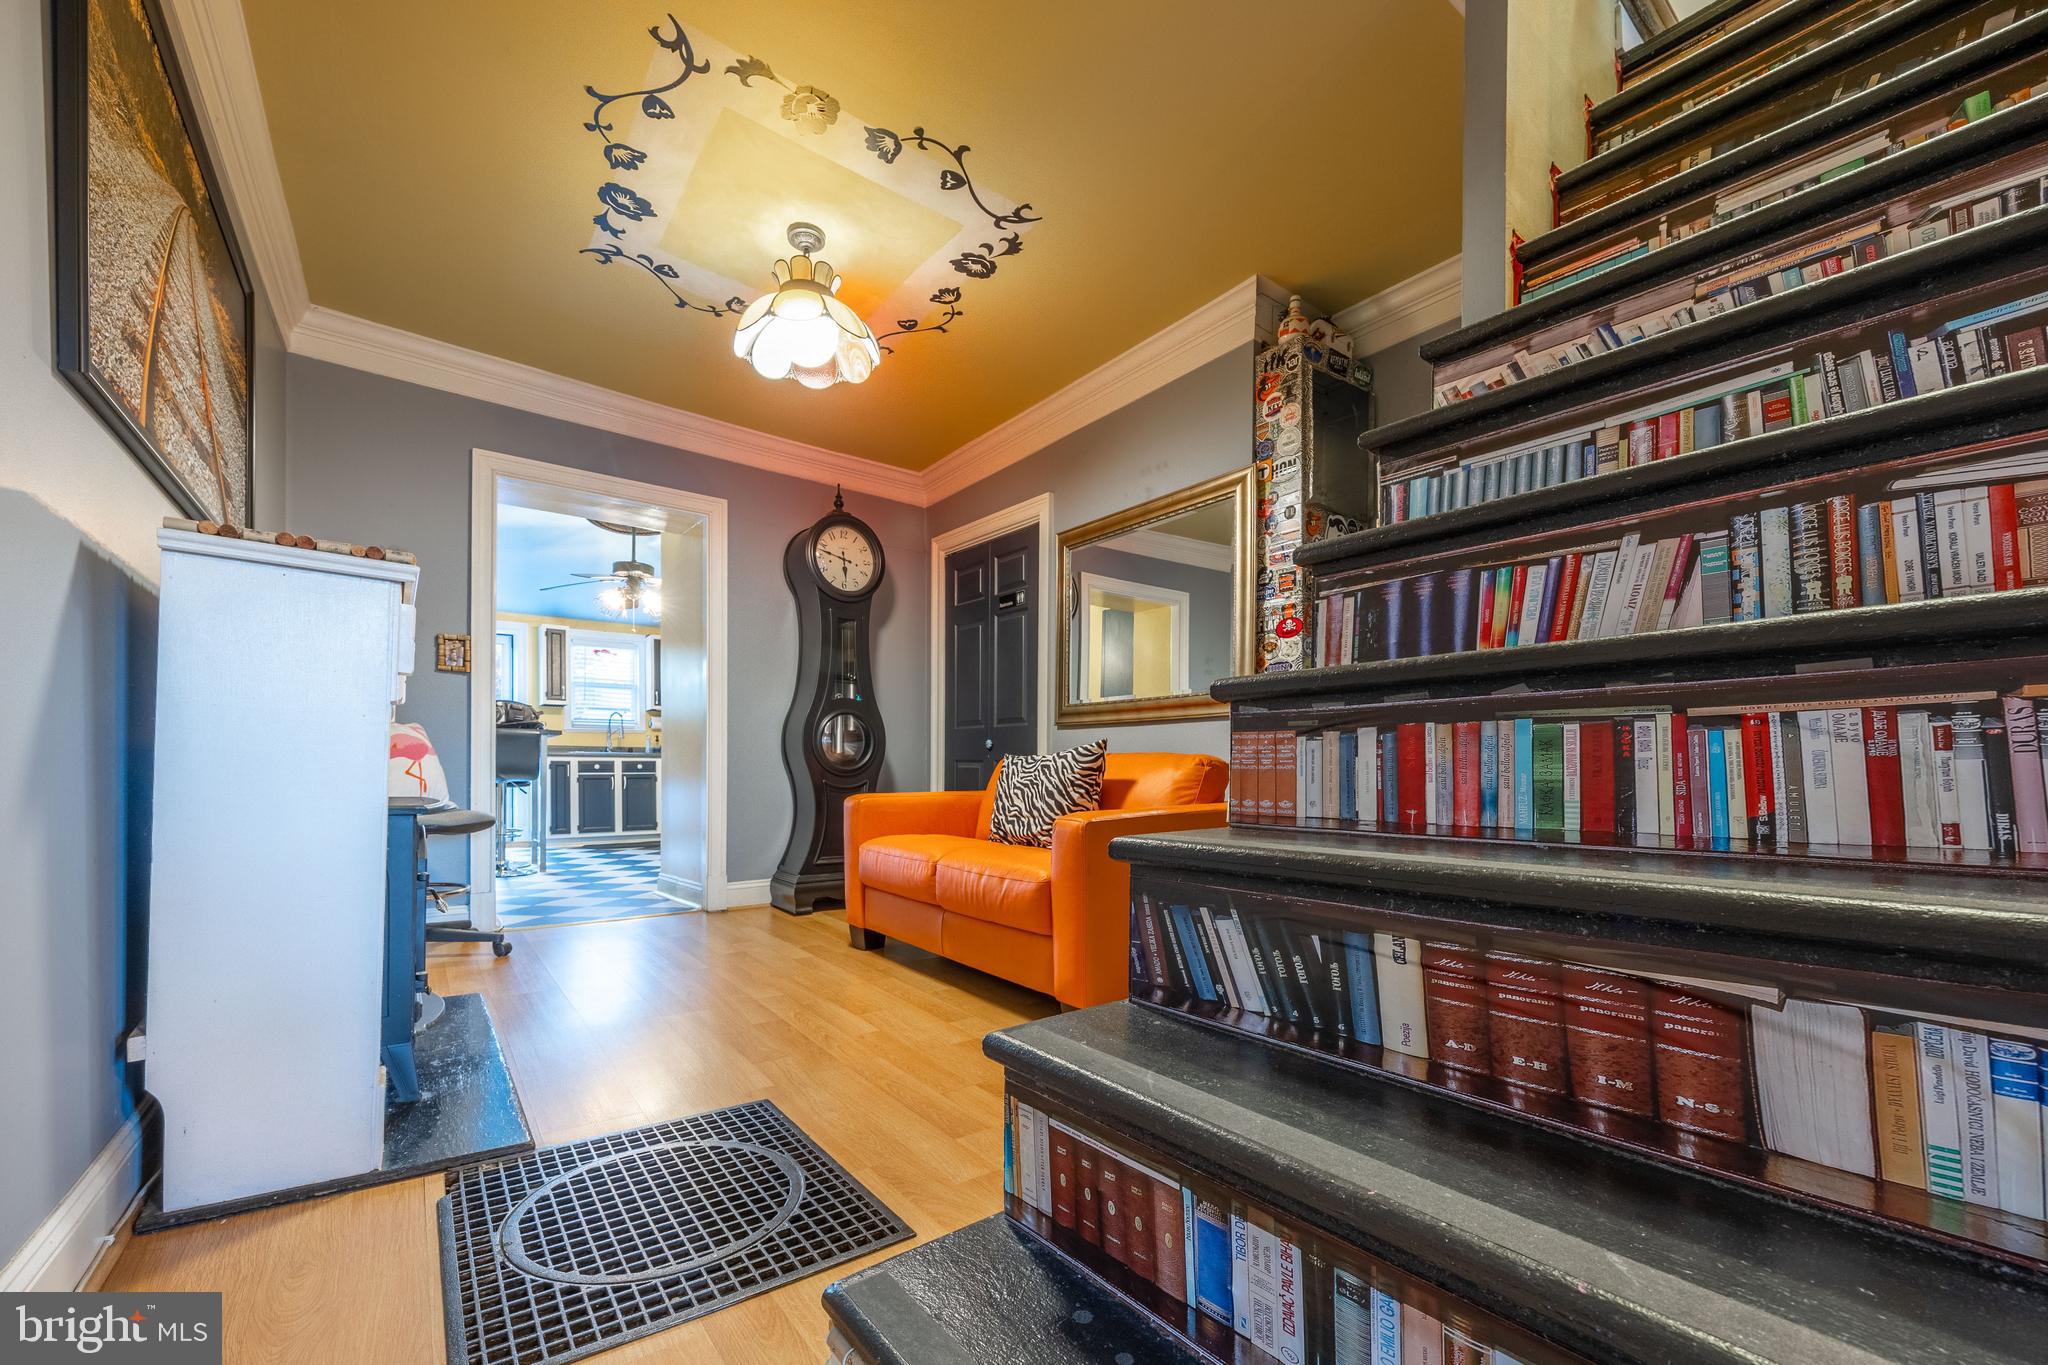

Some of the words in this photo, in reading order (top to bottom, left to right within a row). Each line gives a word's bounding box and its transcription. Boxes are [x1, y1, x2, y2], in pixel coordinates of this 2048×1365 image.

[1822, 352, 1835, 371] svega
[1826, 371, 1837, 386] srce
[1880, 370, 1893, 384] LUK
[1884, 387, 1895, 402] LIRA
[1830, 394, 1844, 415] Ljubav
[1833, 497, 1849, 522] JORGE
[828, 531, 836, 541] 11
[840, 530, 848, 539] 12
[1802, 530, 1819, 546] LUIS
[1834, 523, 1850, 539] LUIS
[1803, 547, 1820, 579] BORGES
[1834, 541, 1852, 573] BORGES
[841, 581, 847, 589] 6
[852, 579, 859, 587] 5
[1906, 576, 1916, 592] VIHORI
[1624, 584, 1642, 609] ŽIVOTI
[2007, 706, 2038, 753] DURAS
[1438, 737, 1449, 753] djela
[1459, 731, 1472, 748] djela
[1485, 736, 1496, 752] djela
[1501, 733, 1512, 751] djela
[1438, 755, 1447, 775] bellow
[1459, 749, 1467, 770] bellow
[1485, 754, 1493, 775] bellow
[1502, 754, 1510, 774] bellow
[1539, 740, 1553, 776] ЗАМАК
[1459, 771, 1467, 784] saul
[1485, 777, 1493, 790] saul
[1502, 775, 1510, 789] saul
[1676, 780, 1686, 796] SIDA
[1540, 782, 1553, 815] КАФКА
[1788, 785, 1800, 832] AMULETI
[1996, 813, 2012, 840] DIRAS
[1392, 935, 1407, 966] CELAN
[1499, 993, 1555, 1006] panorama
[1313, 1016, 1319, 1024] 5
[1580, 1004, 1645, 1021] panorama
[1338, 1023, 1344, 1031] 6
[1400, 1022, 1411, 1047] Poezija
[1962, 1045, 1977, 1068] David
[1935, 1090, 1946, 1104] Luigi
[1968, 1134, 1985, 1157] NEBA
[1970, 1162, 1986, 1196] ZEMLJE
[1235, 1233, 1246, 1262] TIBOR
[1280, 1263, 1294, 1294] PAVLE
[1279, 1293, 1296, 1337] IZDAVAČ
[1379, 1318, 1395, 1358] EMILIO
